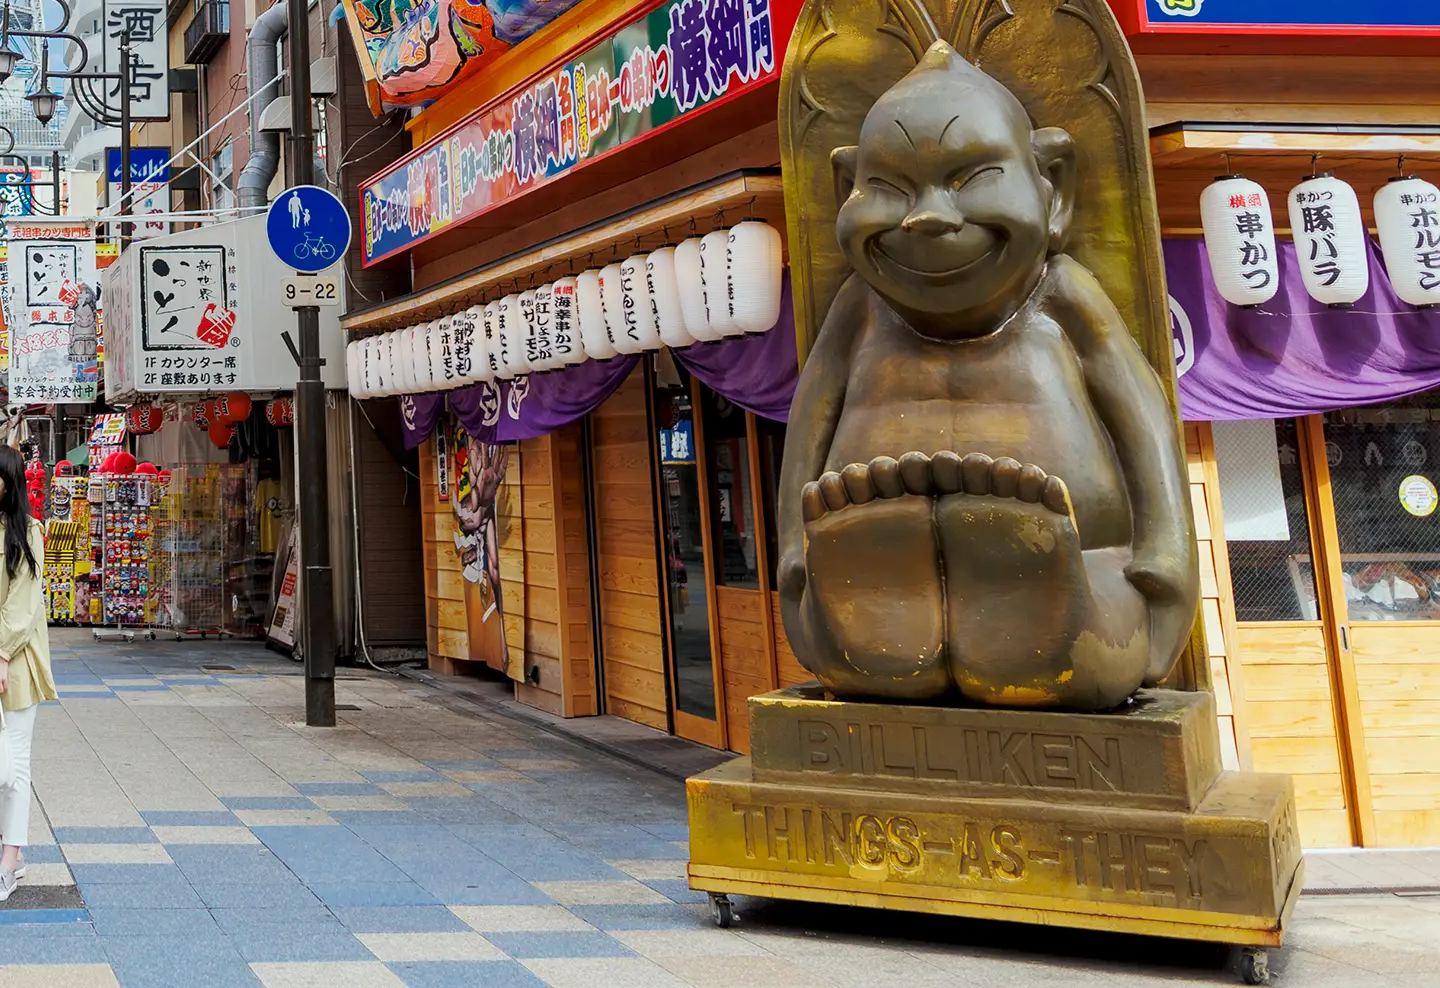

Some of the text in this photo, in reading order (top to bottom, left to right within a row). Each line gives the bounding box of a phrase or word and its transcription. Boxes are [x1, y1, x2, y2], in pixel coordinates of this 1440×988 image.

[588, 50, 669, 133] 日本一の串かつ
[1230, 193, 1262, 208] 横綱
[1296, 190, 1333, 203] 串かつ
[1401, 192, 1437, 204] 串かつ
[12, 227, 91, 238] 元祖串カツ専門店
[1236, 211, 1271, 289] 串かつ
[1302, 204, 1342, 286] 豚バラ
[1411, 207, 1440, 291] ホルモン
[535, 302, 552, 360] 紅しょうが
[145, 356, 237, 369] 1F カウンター席
[144, 373, 237, 385] 2F 座敷あります
[14, 385, 95, 399] 宴会予約受付中
[798, 720, 1127, 792] BILLIKEN
